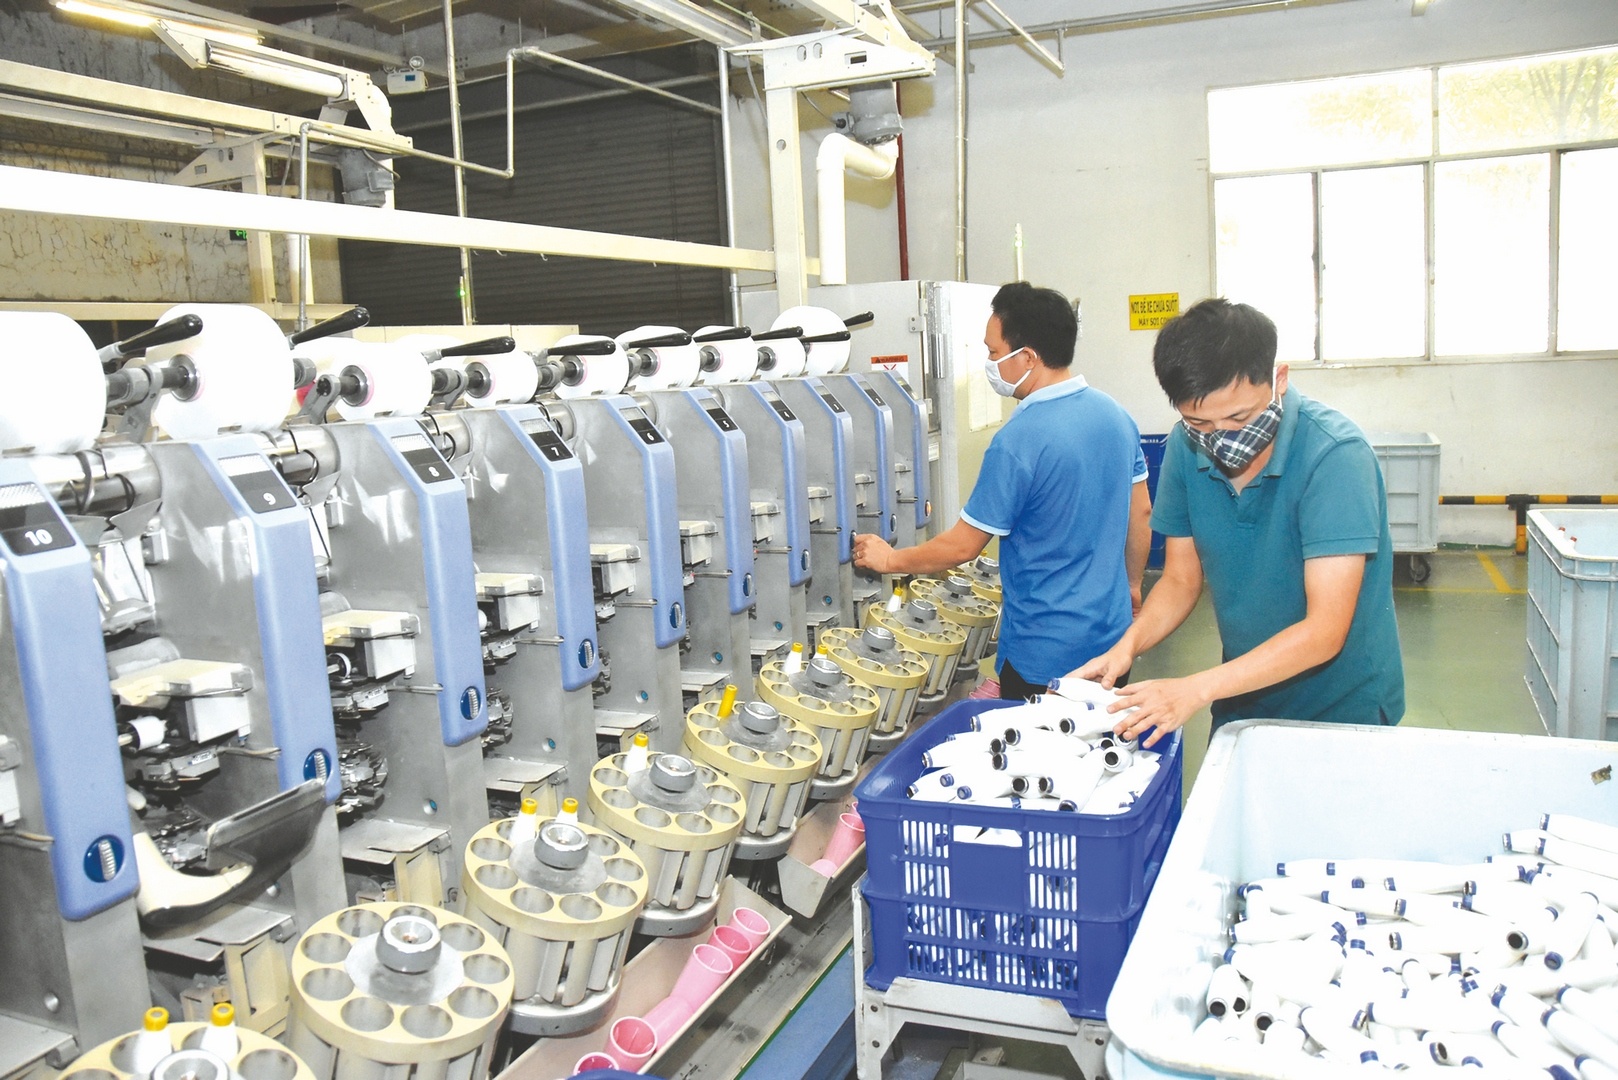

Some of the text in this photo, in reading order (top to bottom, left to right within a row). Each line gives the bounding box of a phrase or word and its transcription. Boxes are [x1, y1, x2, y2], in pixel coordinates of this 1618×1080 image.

[646, 432, 655, 441] 6
[551, 446, 560, 457] 7
[428, 466, 440, 477] 8
[263, 492, 276, 505] 9
[25, 529, 53, 546] 10
